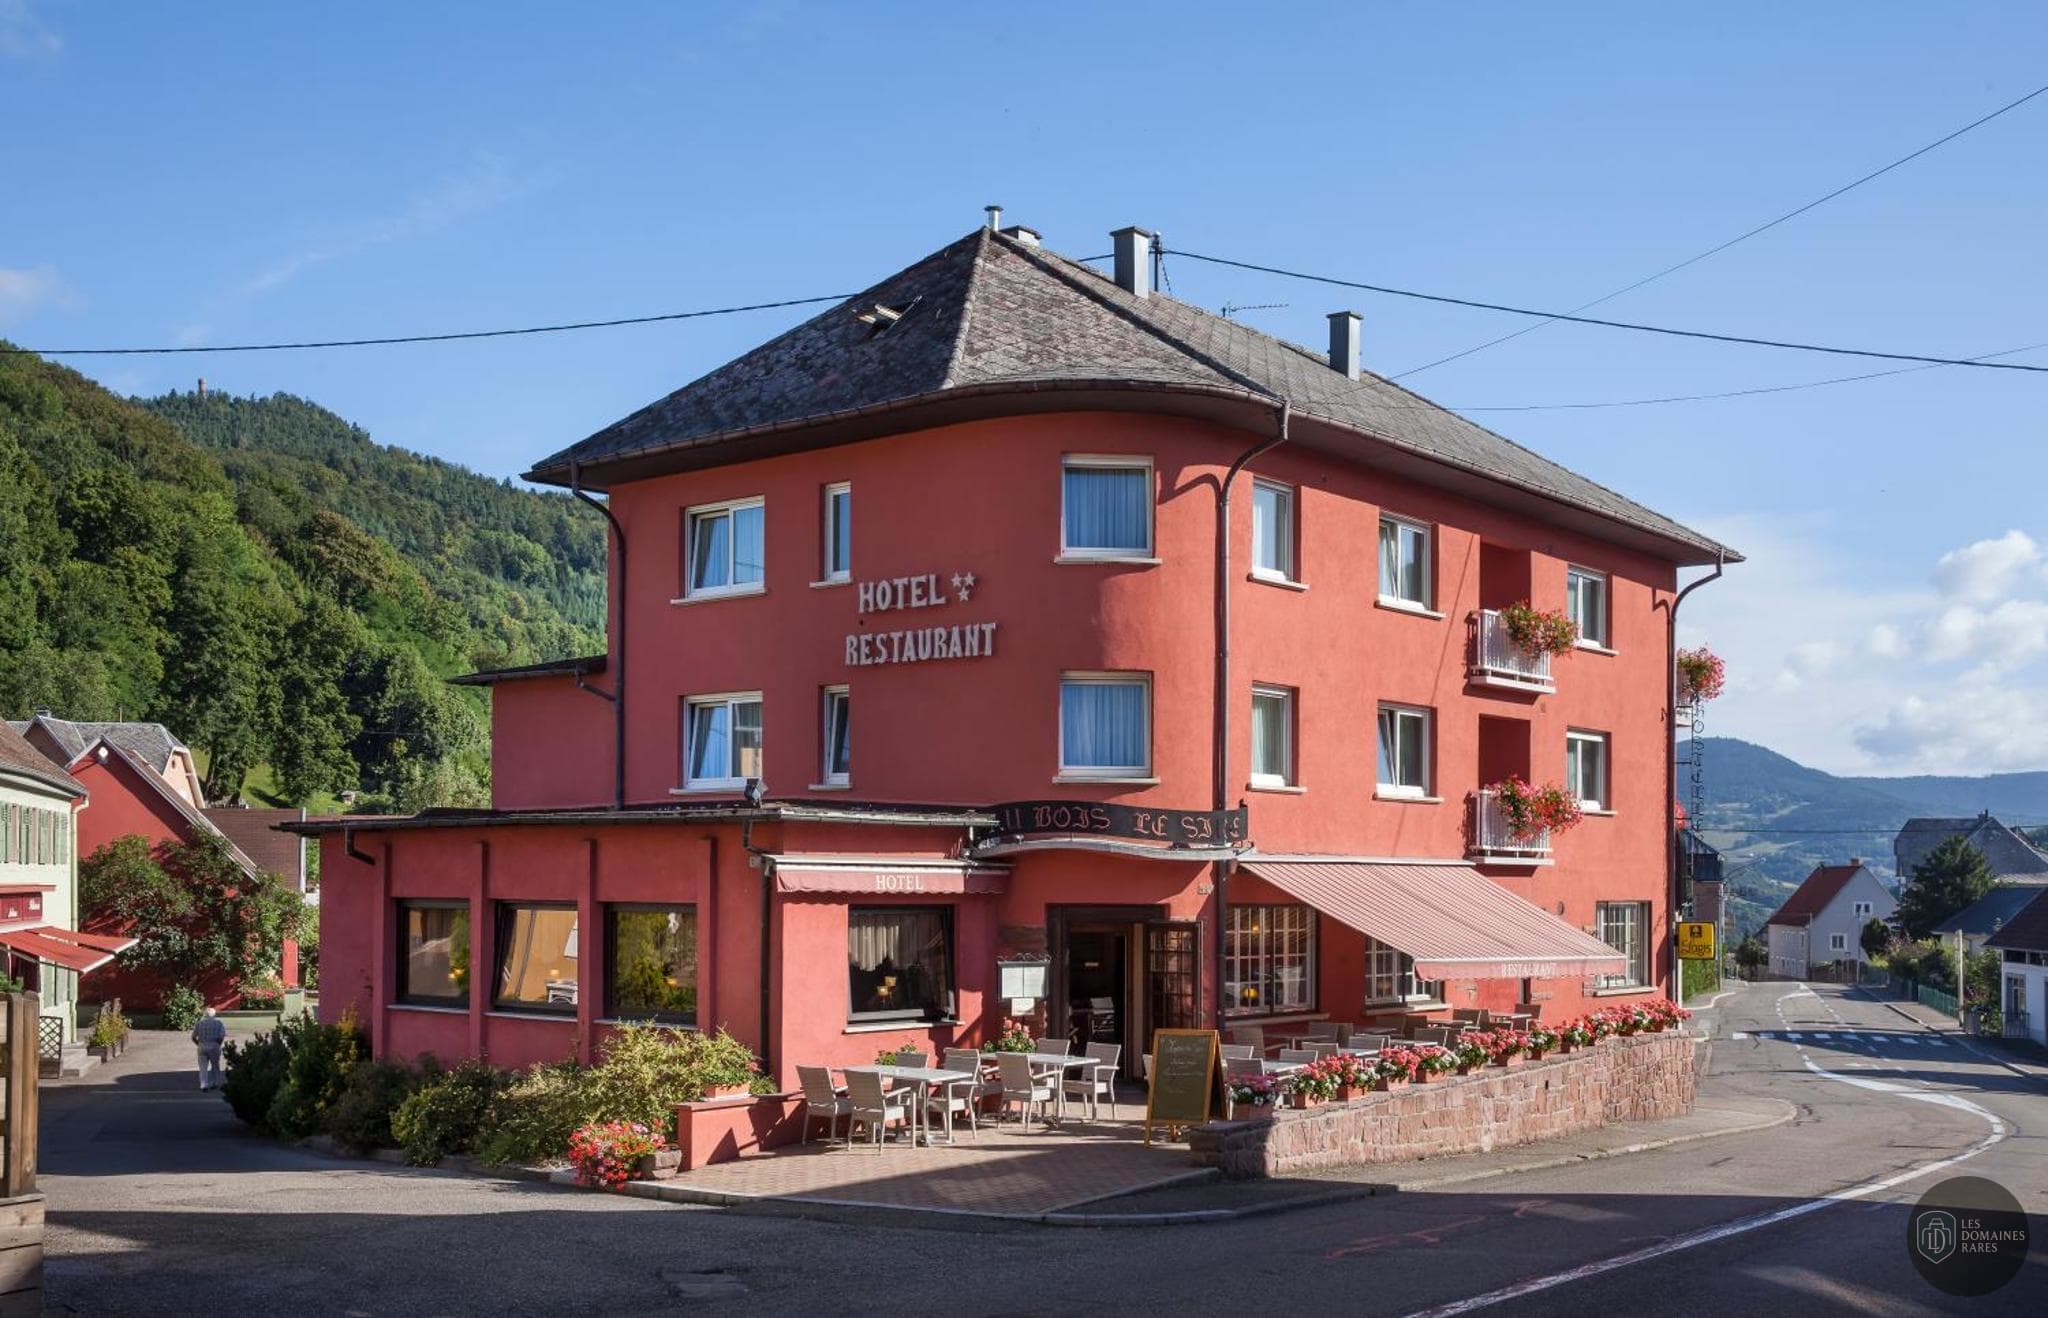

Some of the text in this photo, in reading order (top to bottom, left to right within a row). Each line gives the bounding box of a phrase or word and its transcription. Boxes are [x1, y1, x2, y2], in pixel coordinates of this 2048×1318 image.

[858, 574, 946, 613] HOTEL
[845, 622, 996, 666] RESTAURANT
[1033, 805, 1111, 830] BOIS
[1135, 811, 1169, 835] LE
[875, 874, 924, 890] HOTEL
